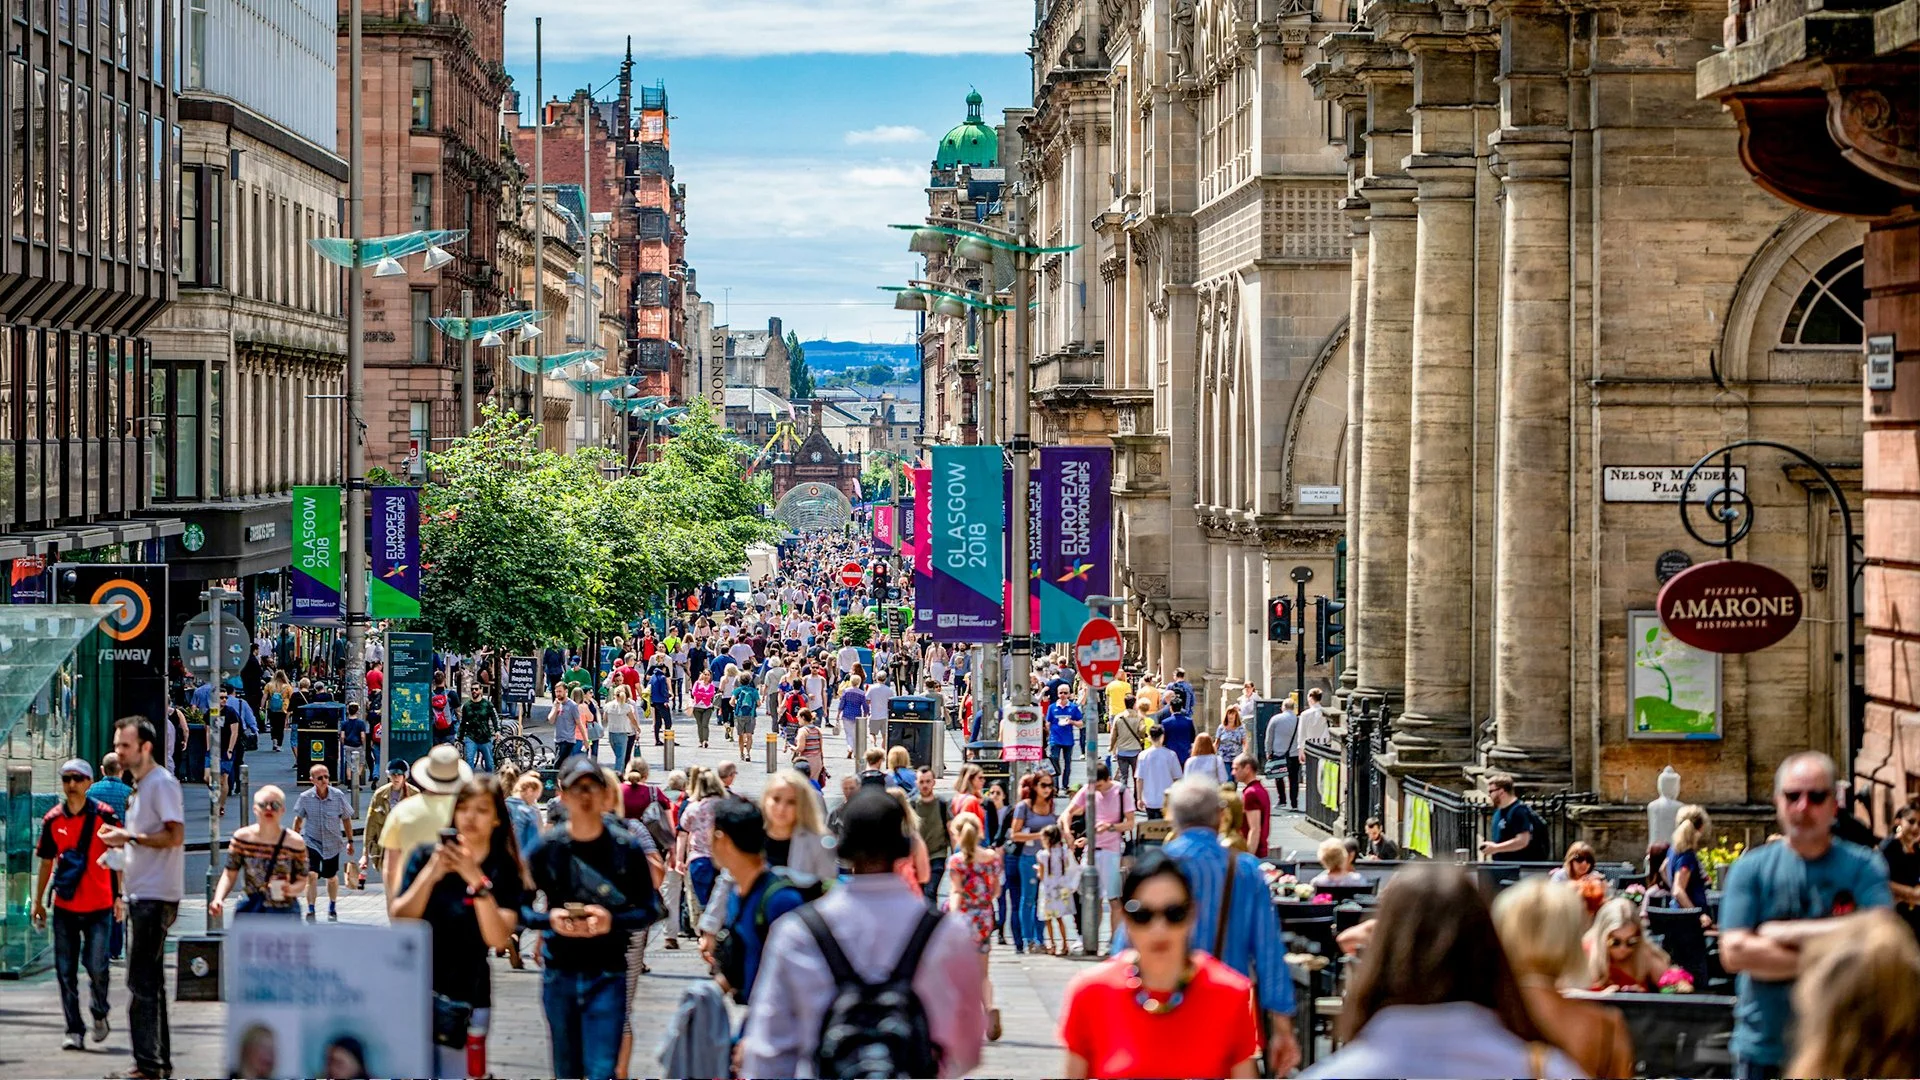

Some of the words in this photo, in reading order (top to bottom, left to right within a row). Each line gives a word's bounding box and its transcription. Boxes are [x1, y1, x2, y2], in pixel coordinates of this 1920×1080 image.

[712, 335, 724, 351] ST
[1610, 469, 1663, 480] NELSON
[386, 496, 397, 560] EUROPEAN
[397, 496, 405, 560] CHAMPIONSHIPS
[948, 462, 966, 567] GLASGOW
[1061, 461, 1077, 556] EUROPEAN
[1078, 461, 1090, 556] CHAMPIONSHIPS
[303, 497, 316, 568] GLASGOW
[317, 537, 329, 568] 2018
[968, 522, 986, 567] 2018
[1669, 597, 1795, 619] AMARONE
[1704, 587, 1758, 596] PIZZERIA
[1695, 620, 1768, 629] RISTORANTE
